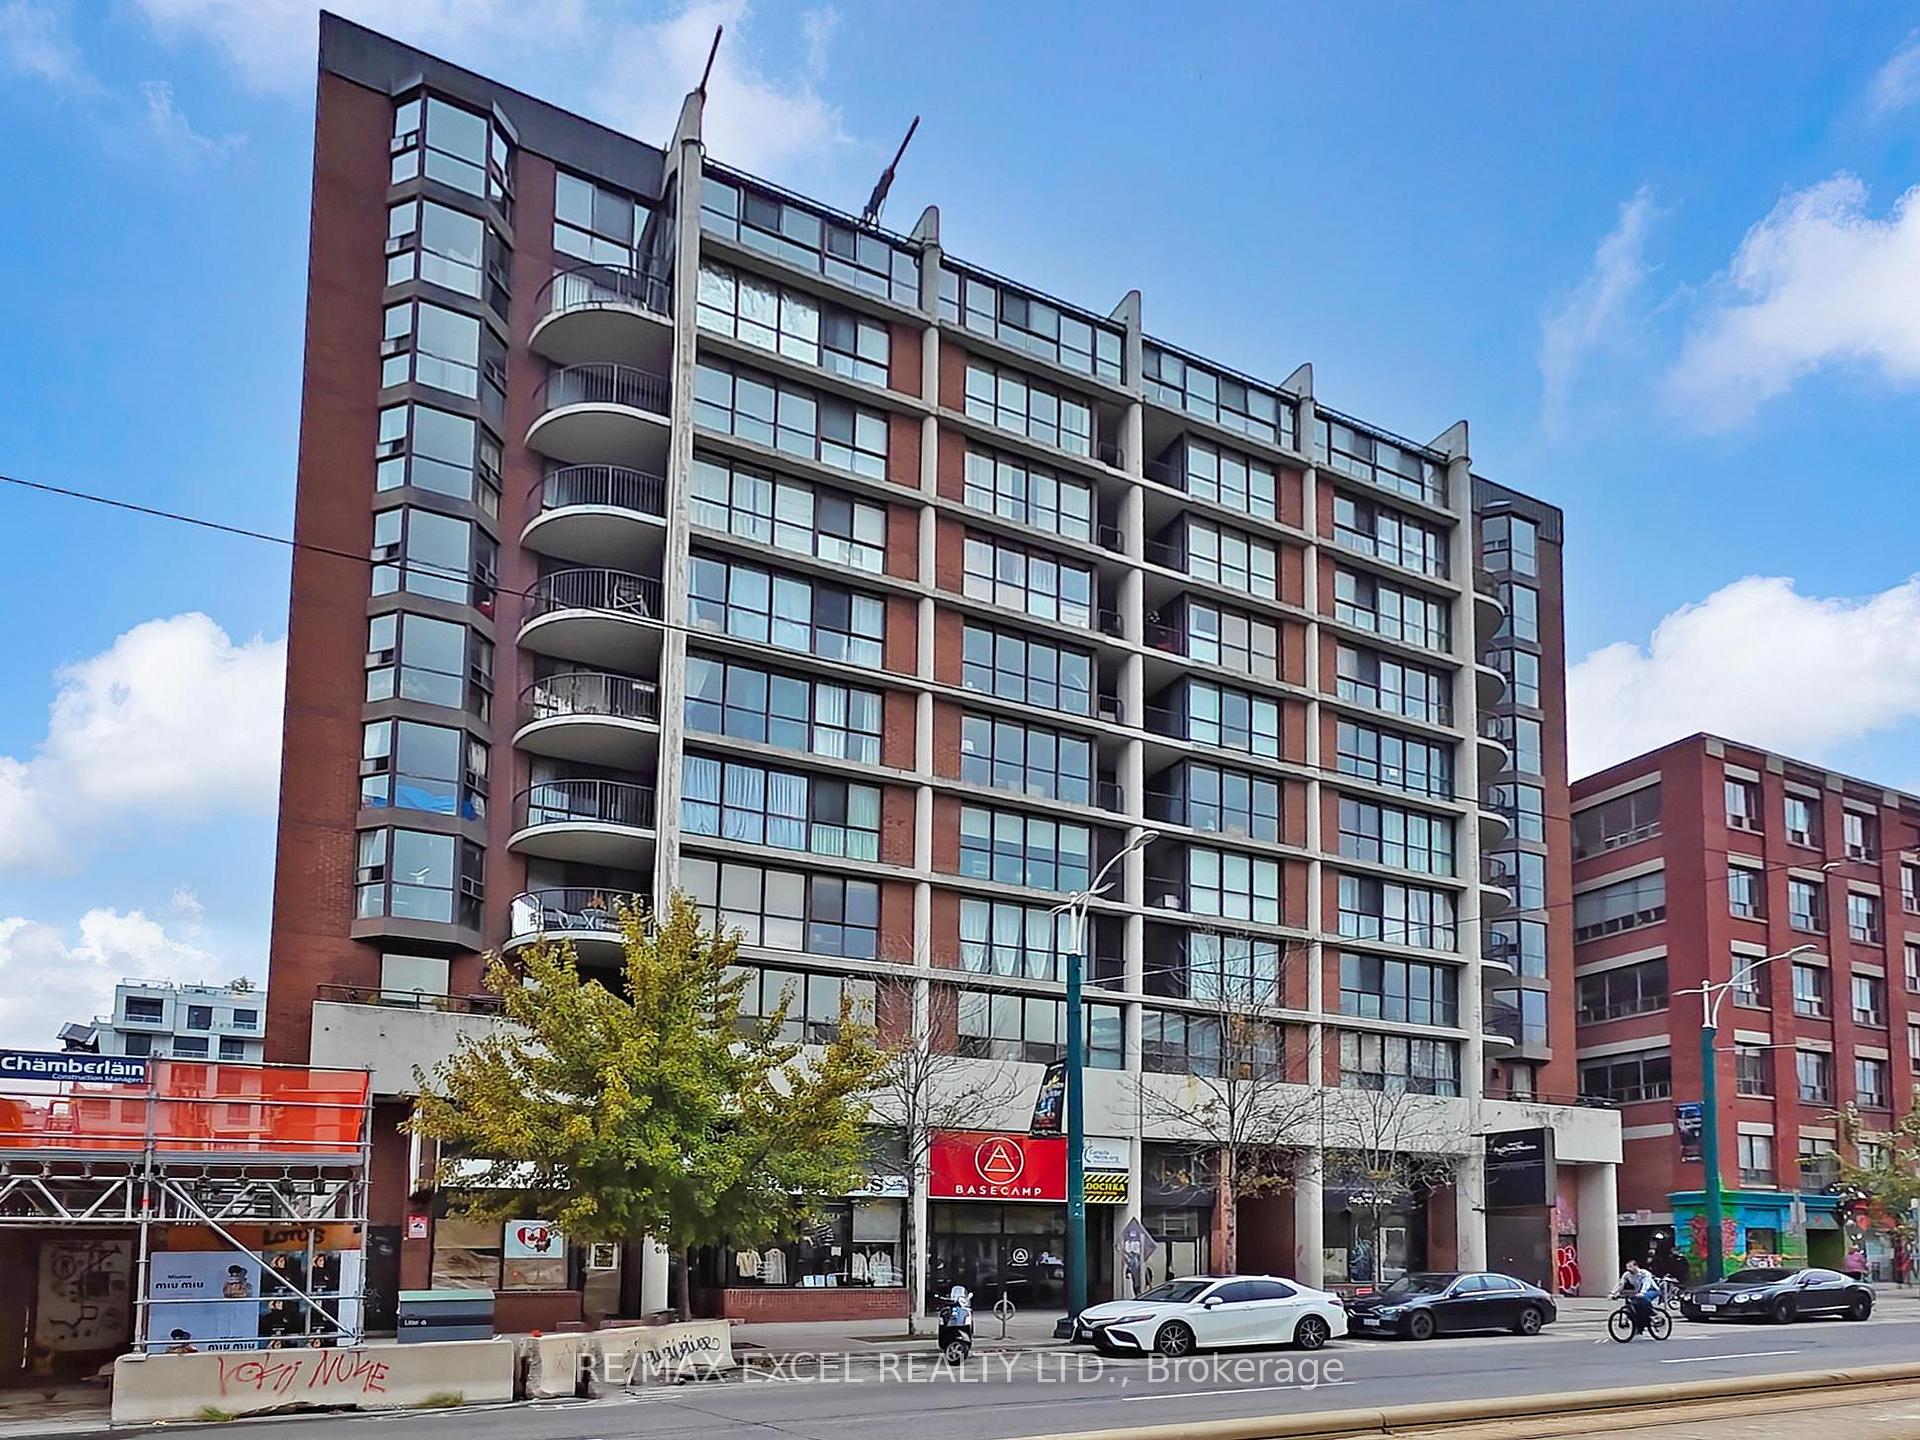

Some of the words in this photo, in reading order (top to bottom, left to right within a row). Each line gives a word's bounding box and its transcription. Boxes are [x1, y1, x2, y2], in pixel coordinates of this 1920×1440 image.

[52, 1073, 103, 1081] Construction
[955, 1185, 1042, 1197] BASECAMP
[155, 1282, 179, 1290] miu
[180, 1281, 204, 1289] miu
